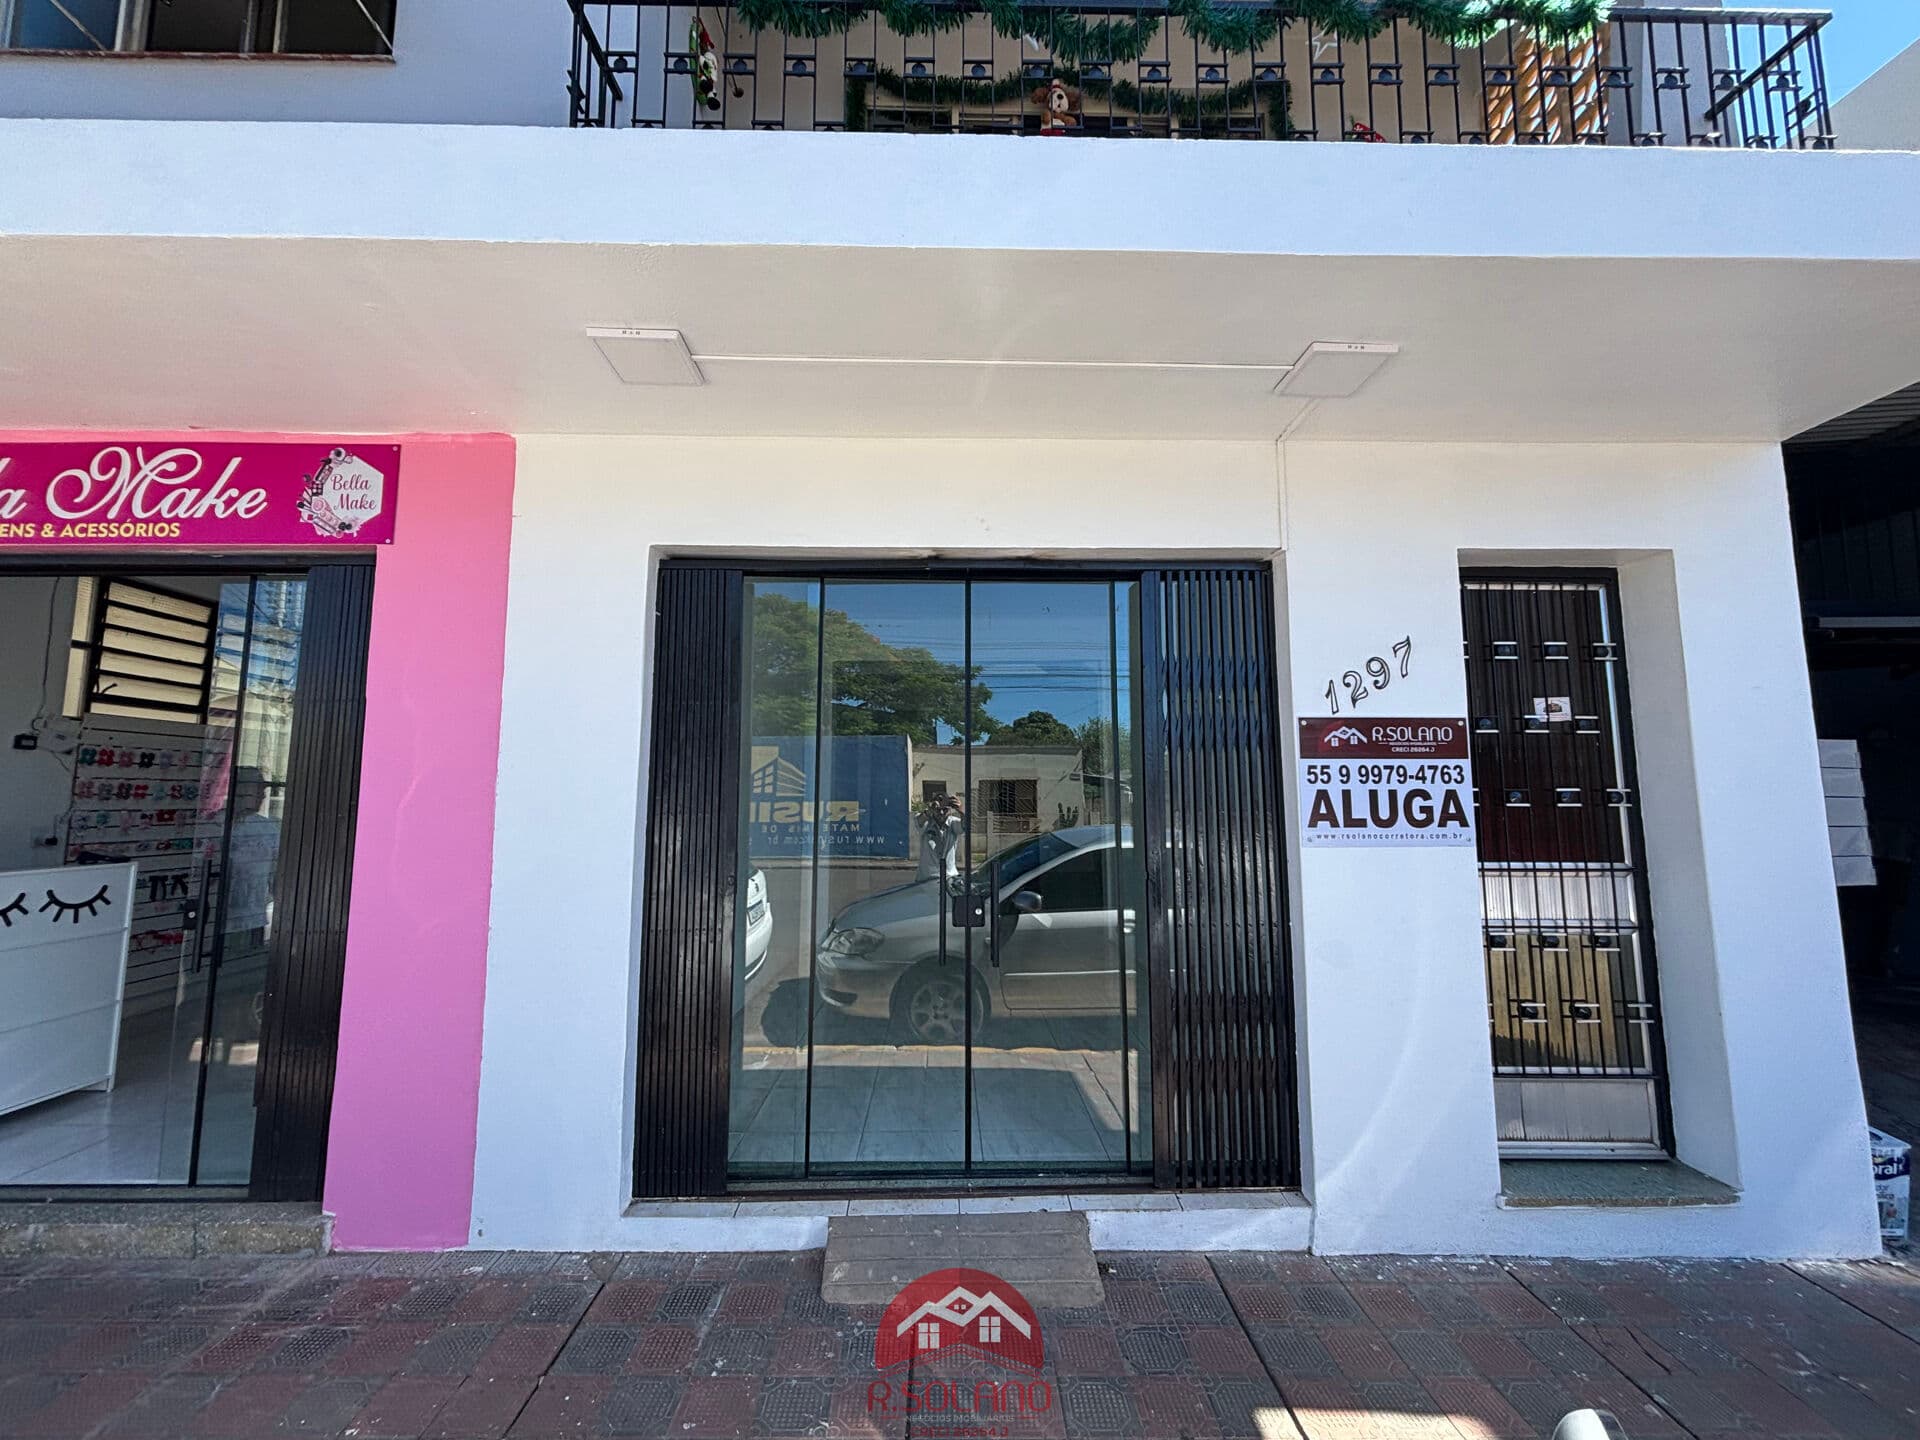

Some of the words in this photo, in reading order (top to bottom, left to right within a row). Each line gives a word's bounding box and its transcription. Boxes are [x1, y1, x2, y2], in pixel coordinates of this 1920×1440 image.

[46, 446, 268, 520] Make
[331, 473, 372, 491] Bella
[333, 493, 377, 511] Make
[41, 523, 55, 538] &
[60, 519, 181, 538] ACESSÓRIOS
[1325, 635, 1412, 715] 1297
[1372, 726, 1453, 742] R.SOLANO
[1307, 765, 1331, 784] 55
[1338, 765, 1351, 784] 9
[1358, 764, 1465, 785] 9979-4763
[1307, 789, 1470, 829] ALUGA
